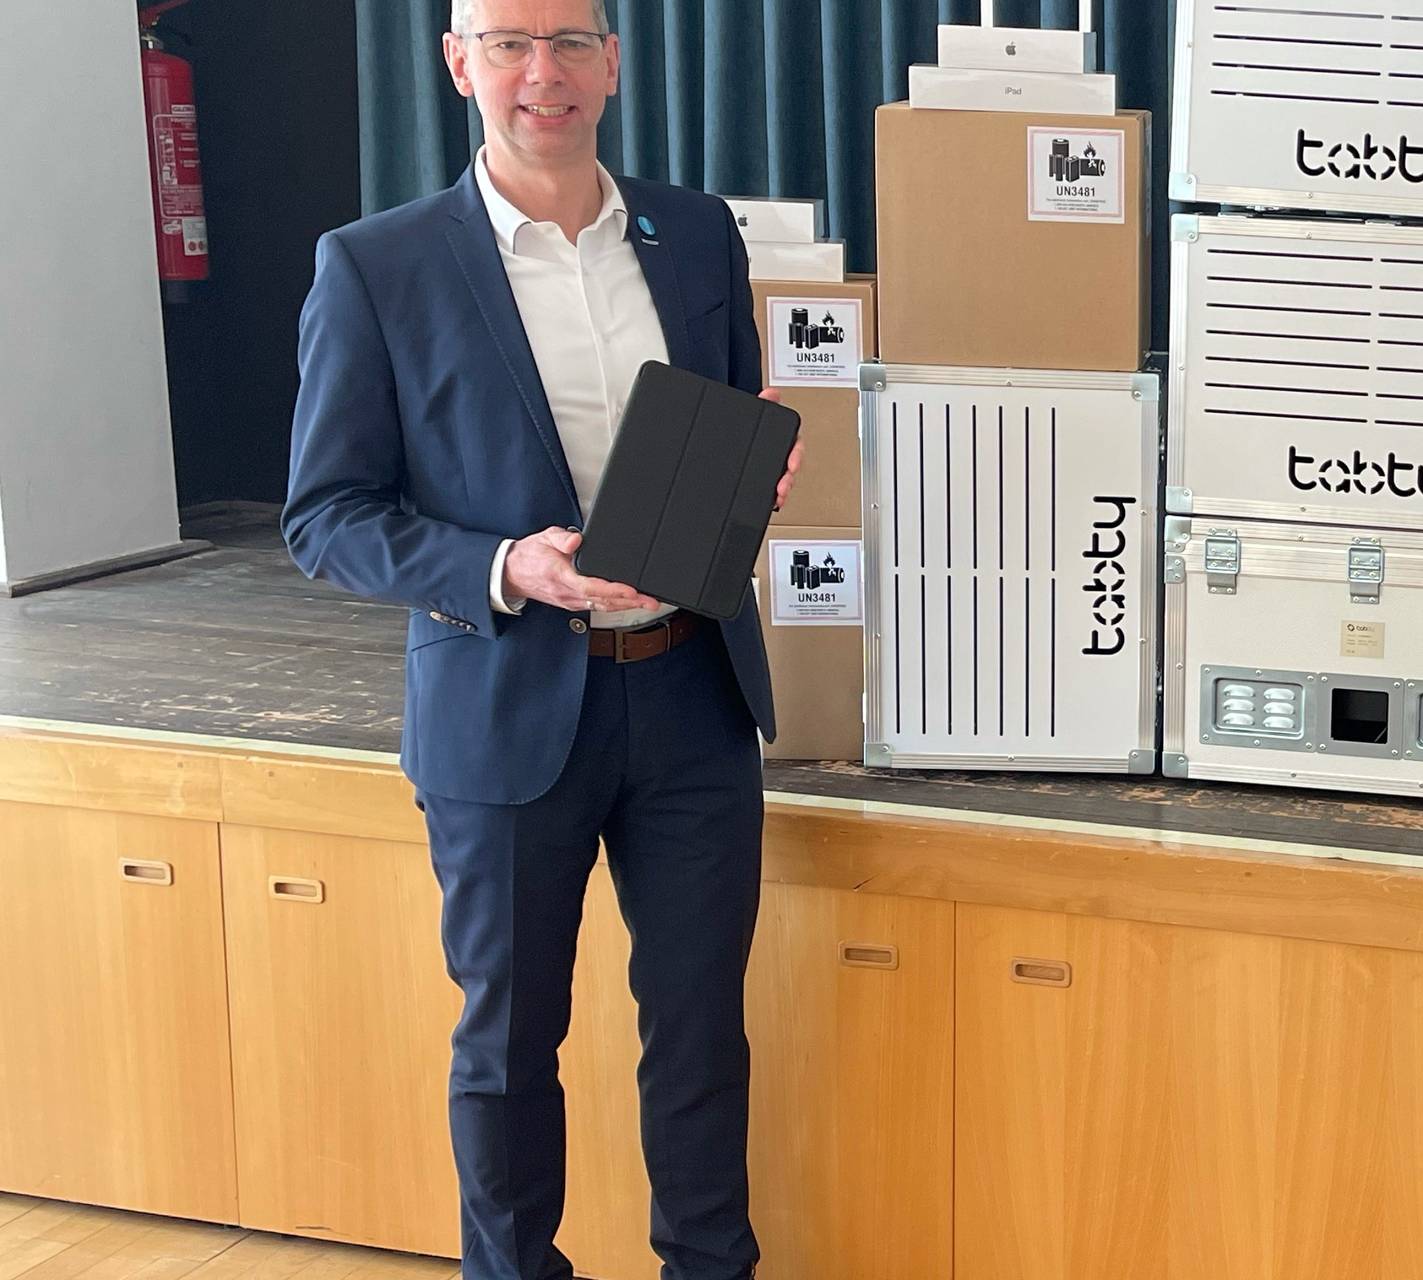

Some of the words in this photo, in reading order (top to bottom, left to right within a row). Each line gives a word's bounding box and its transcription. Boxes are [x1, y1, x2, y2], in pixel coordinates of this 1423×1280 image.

[1004, 86, 1022, 95] iPad
[1056, 186, 1096, 197] UN3481
[796, 352, 835, 363] UN3481
[1080, 495, 1137, 656] tabty
[798, 592, 836, 603] UN3481
